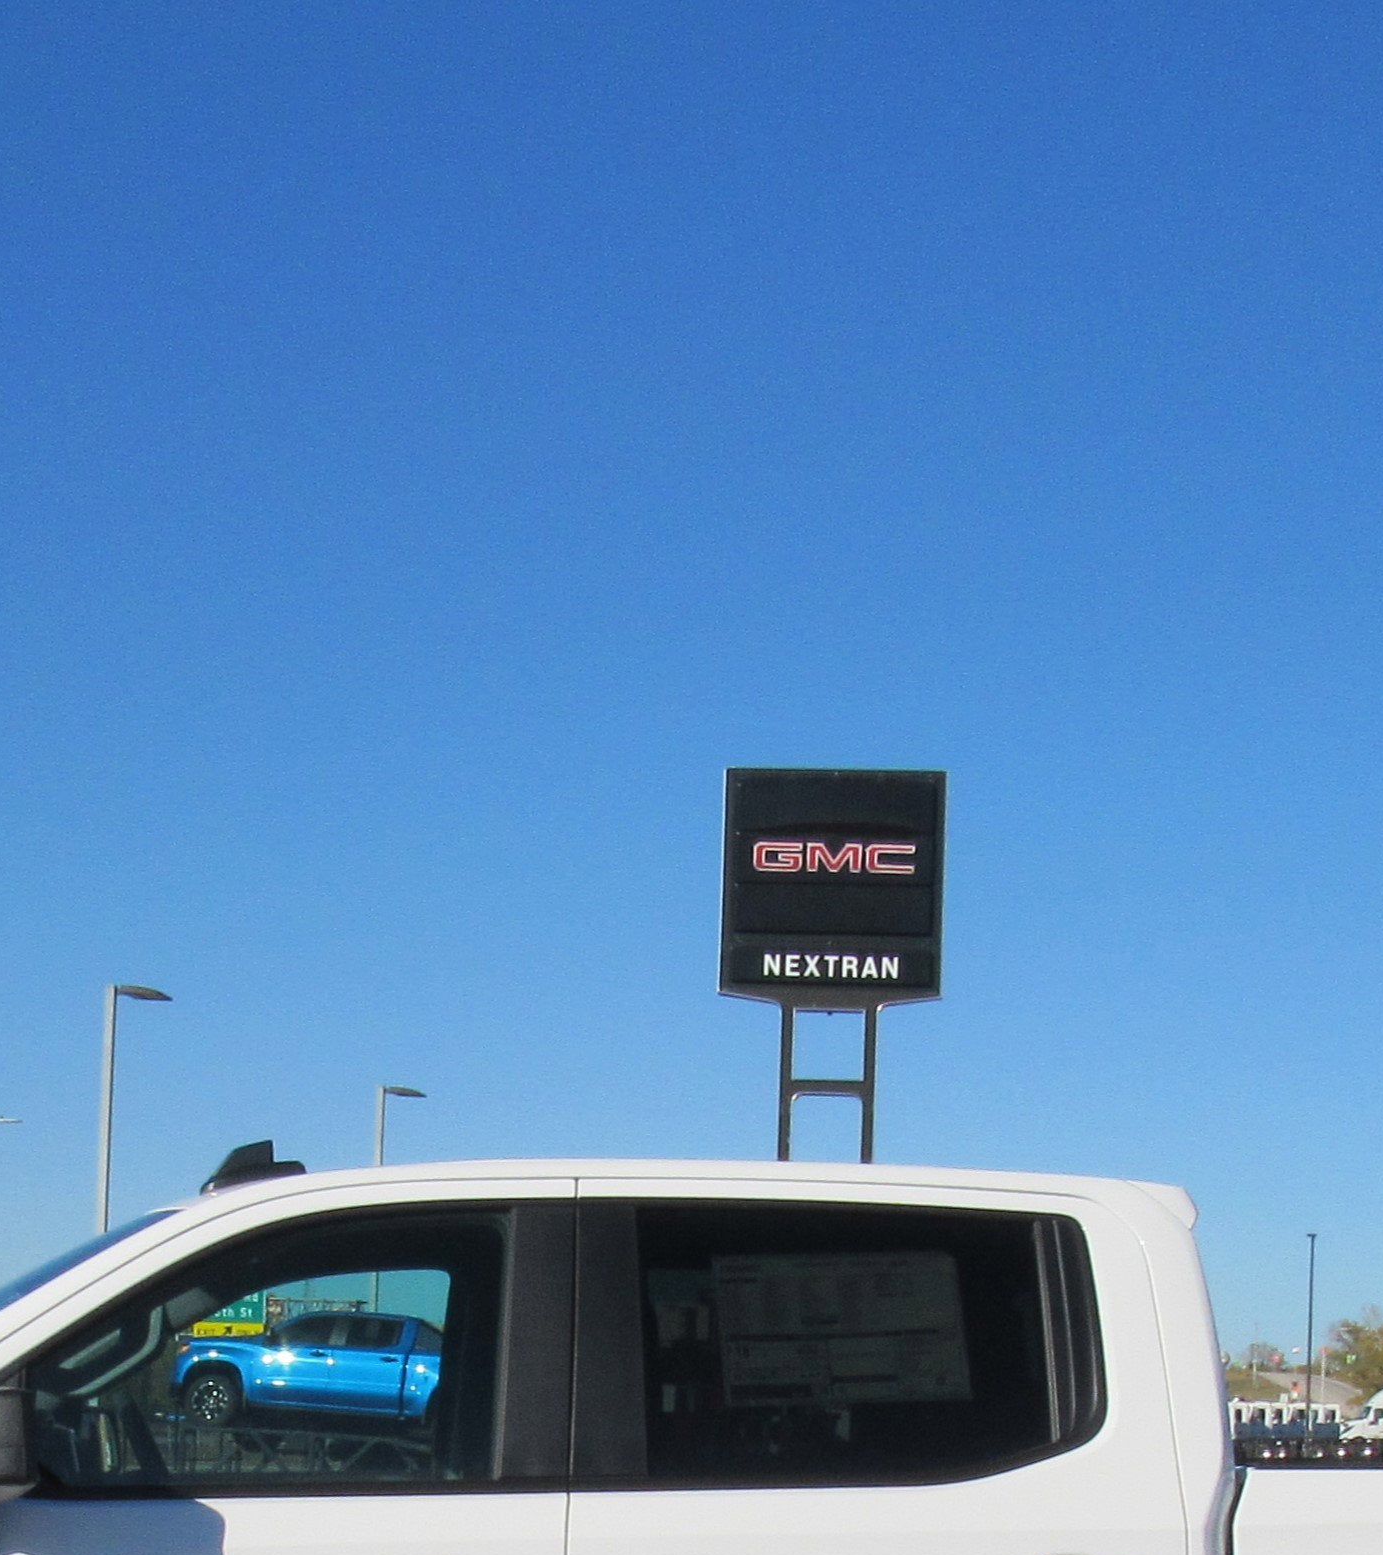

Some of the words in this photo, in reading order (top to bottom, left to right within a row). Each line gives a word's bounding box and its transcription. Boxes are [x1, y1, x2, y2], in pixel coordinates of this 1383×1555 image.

[752, 841, 916, 874] GMC
[762, 953, 900, 980] NEXTRAN
[240, 1307, 253, 1318] St
